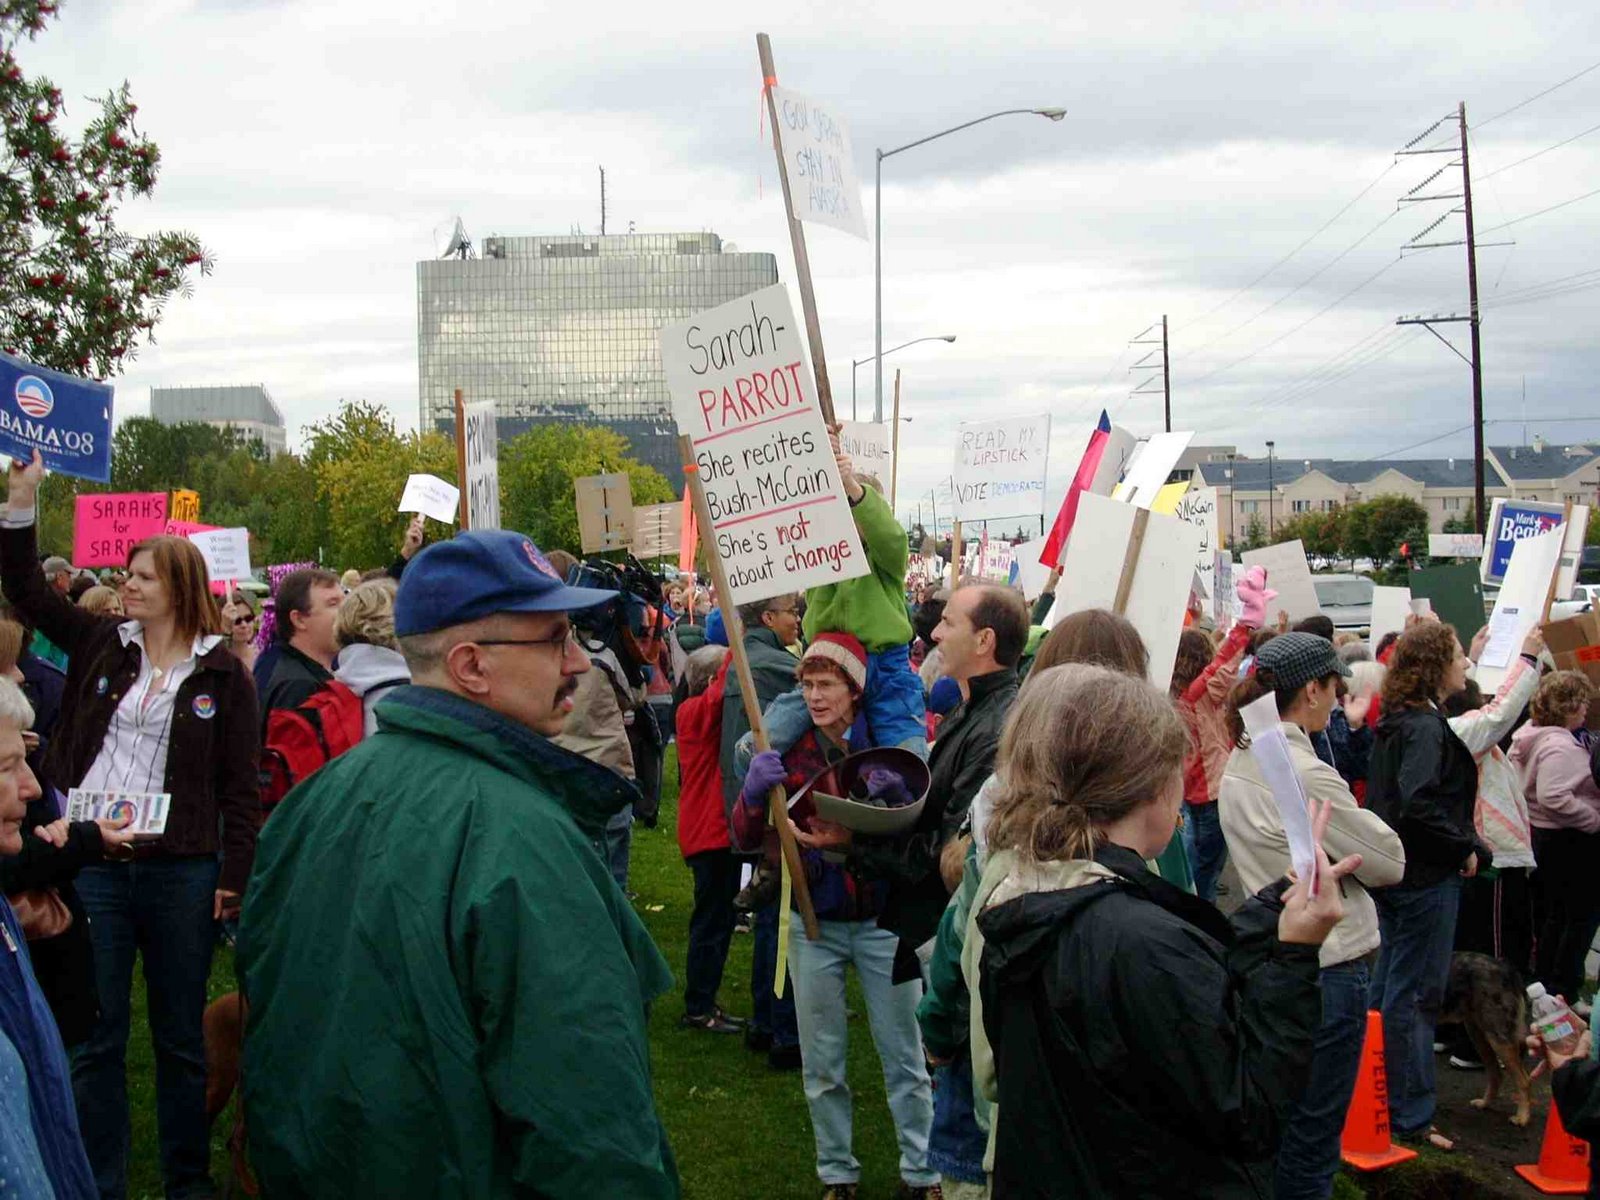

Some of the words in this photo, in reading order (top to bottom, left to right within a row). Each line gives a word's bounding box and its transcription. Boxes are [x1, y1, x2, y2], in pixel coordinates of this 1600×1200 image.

[686, 300, 785, 375] Sarah-
[698, 361, 803, 432] PARROT
[0, 409, 94, 455] BAMA'08
[961, 429, 1007, 450] READ
[1019, 426, 1035, 444] MY
[697, 450, 735, 483] She
[742, 431, 815, 470] recites
[973, 448, 1028, 466] LIPSTICK
[93, 498, 163, 519] SARAH'S
[707, 465, 830, 521] Bush-McCain
[956, 482, 988, 505] VOTE
[112, 519, 130, 534] for
[717, 530, 768, 559] She's
[775, 511, 810, 545] not
[1515, 512, 1536, 526] Mark
[90, 539, 143, 558] SARA
[729, 555, 774, 589] about
[784, 539, 852, 572] change
[1372, 1049, 1387, 1135] PEOPLE
